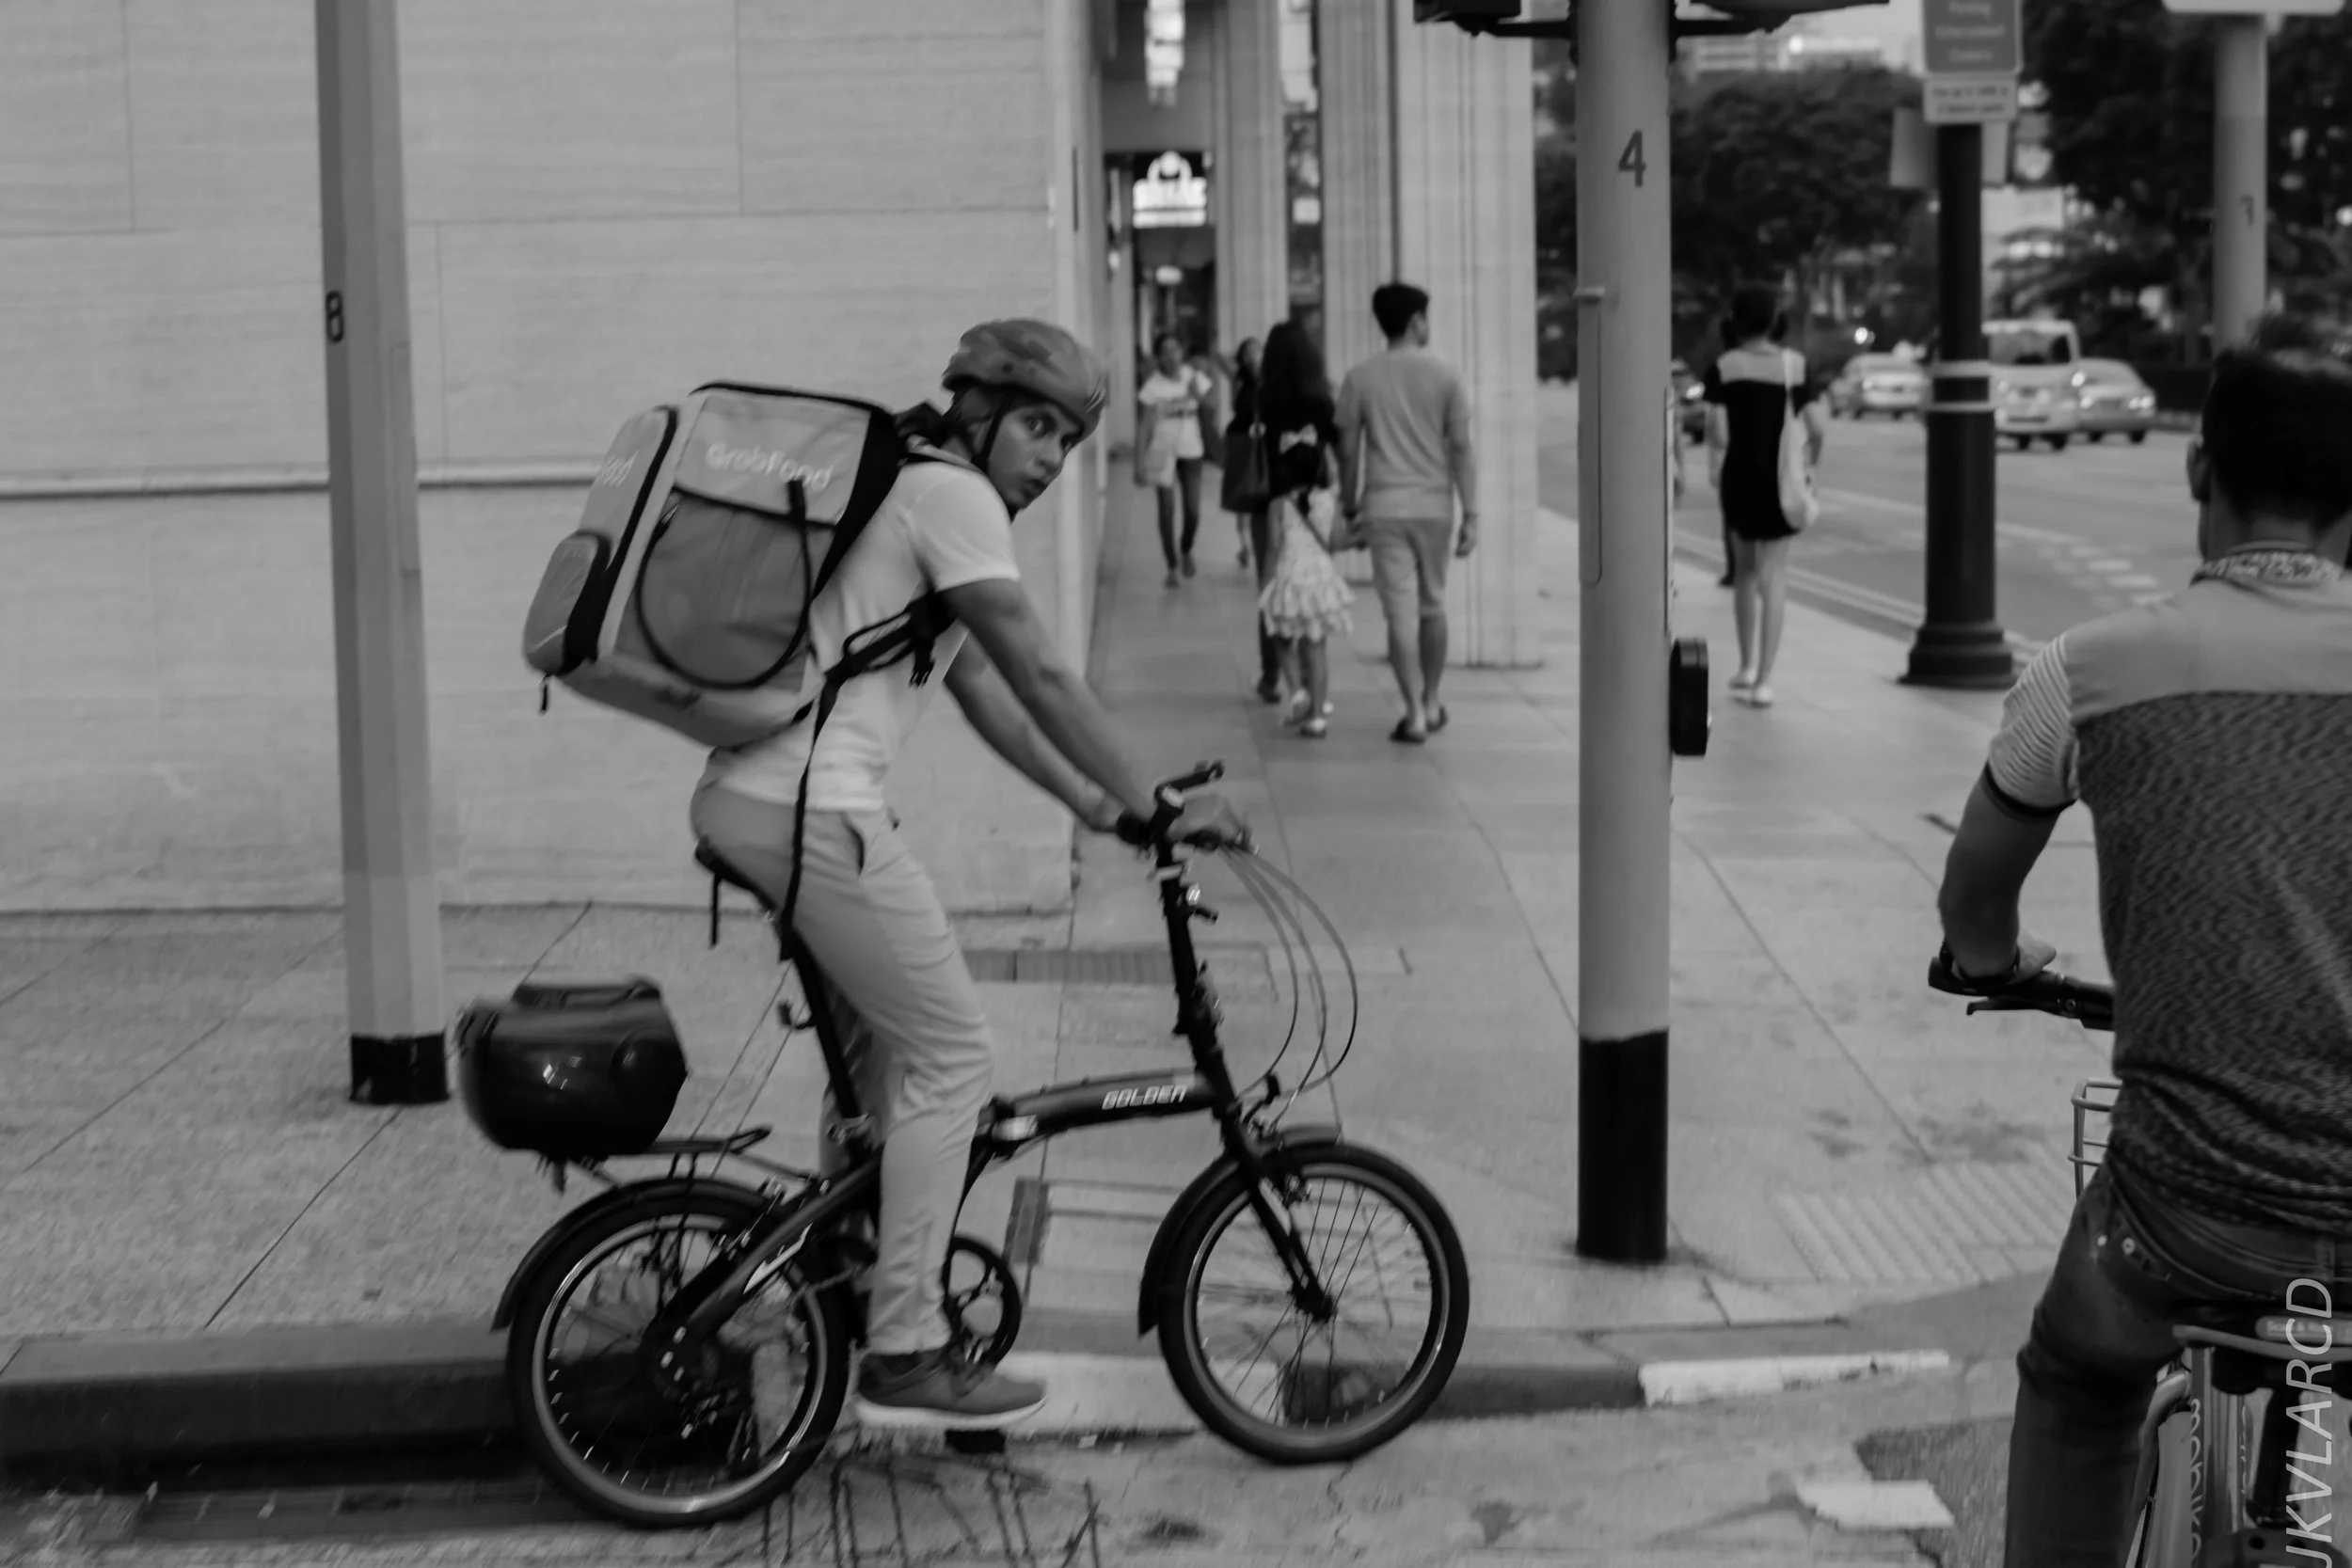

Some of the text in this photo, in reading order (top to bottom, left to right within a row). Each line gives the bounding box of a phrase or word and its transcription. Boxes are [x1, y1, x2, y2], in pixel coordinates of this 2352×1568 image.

[1618, 129, 1646, 188] 4
[326, 290, 345, 344] 8
[705, 442, 834, 491] GrabFood
[1102, 1085, 1187, 1110] GOLDEN
